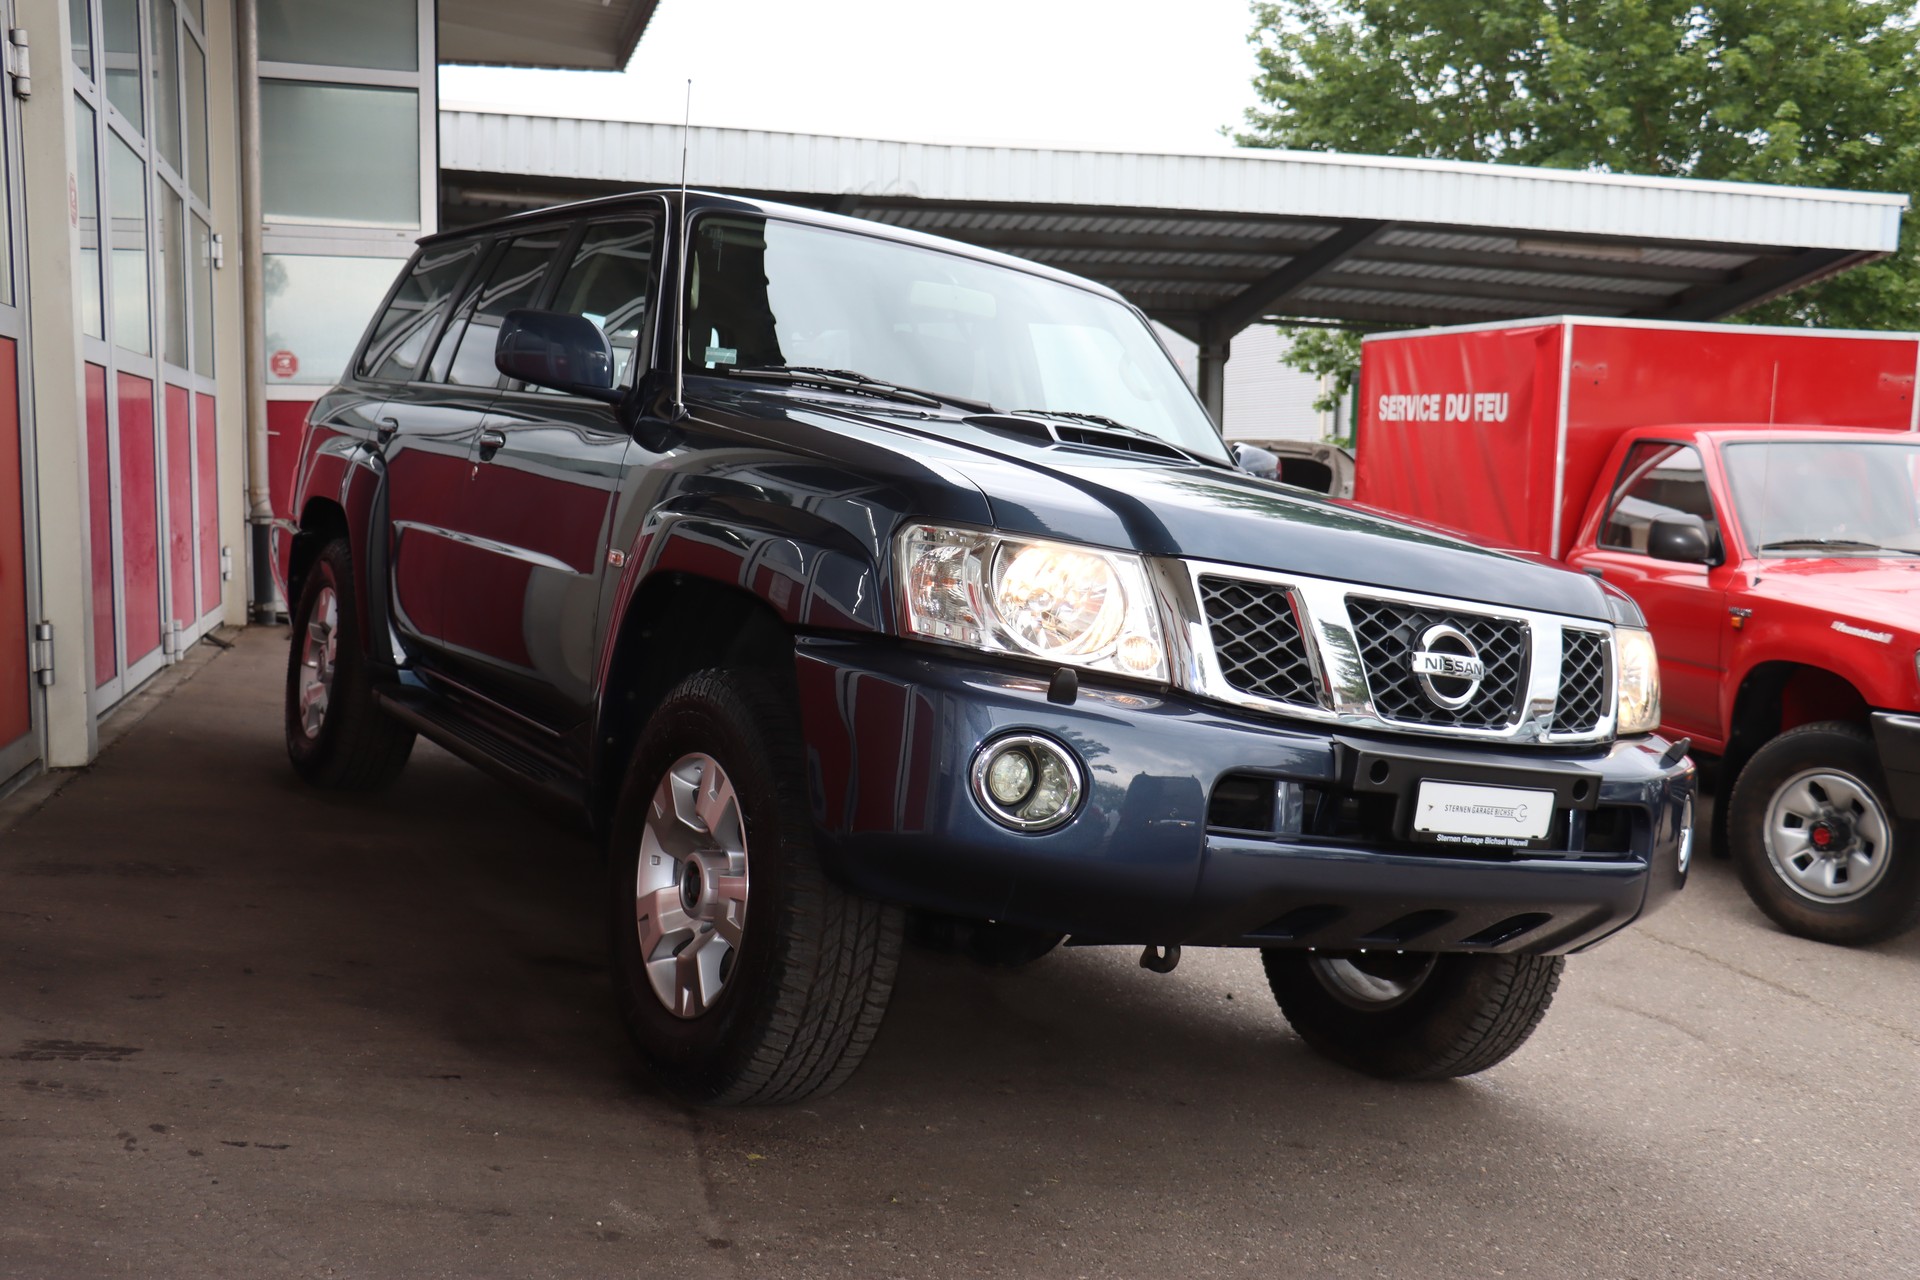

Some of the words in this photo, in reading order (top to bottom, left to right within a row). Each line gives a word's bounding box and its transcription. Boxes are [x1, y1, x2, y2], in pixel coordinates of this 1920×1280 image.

[1379, 394, 1441, 421] SERVICE
[1445, 393, 1471, 421] DU
[1474, 392, 1508, 421] FEU
[1425, 658, 1482, 675] NISSAN
[1444, 804, 1471, 813] STERNEN
[1472, 806, 1493, 815] GARAGE
[1436, 834, 1460, 842] Sternen
[1462, 835, 1483, 845] Garage
